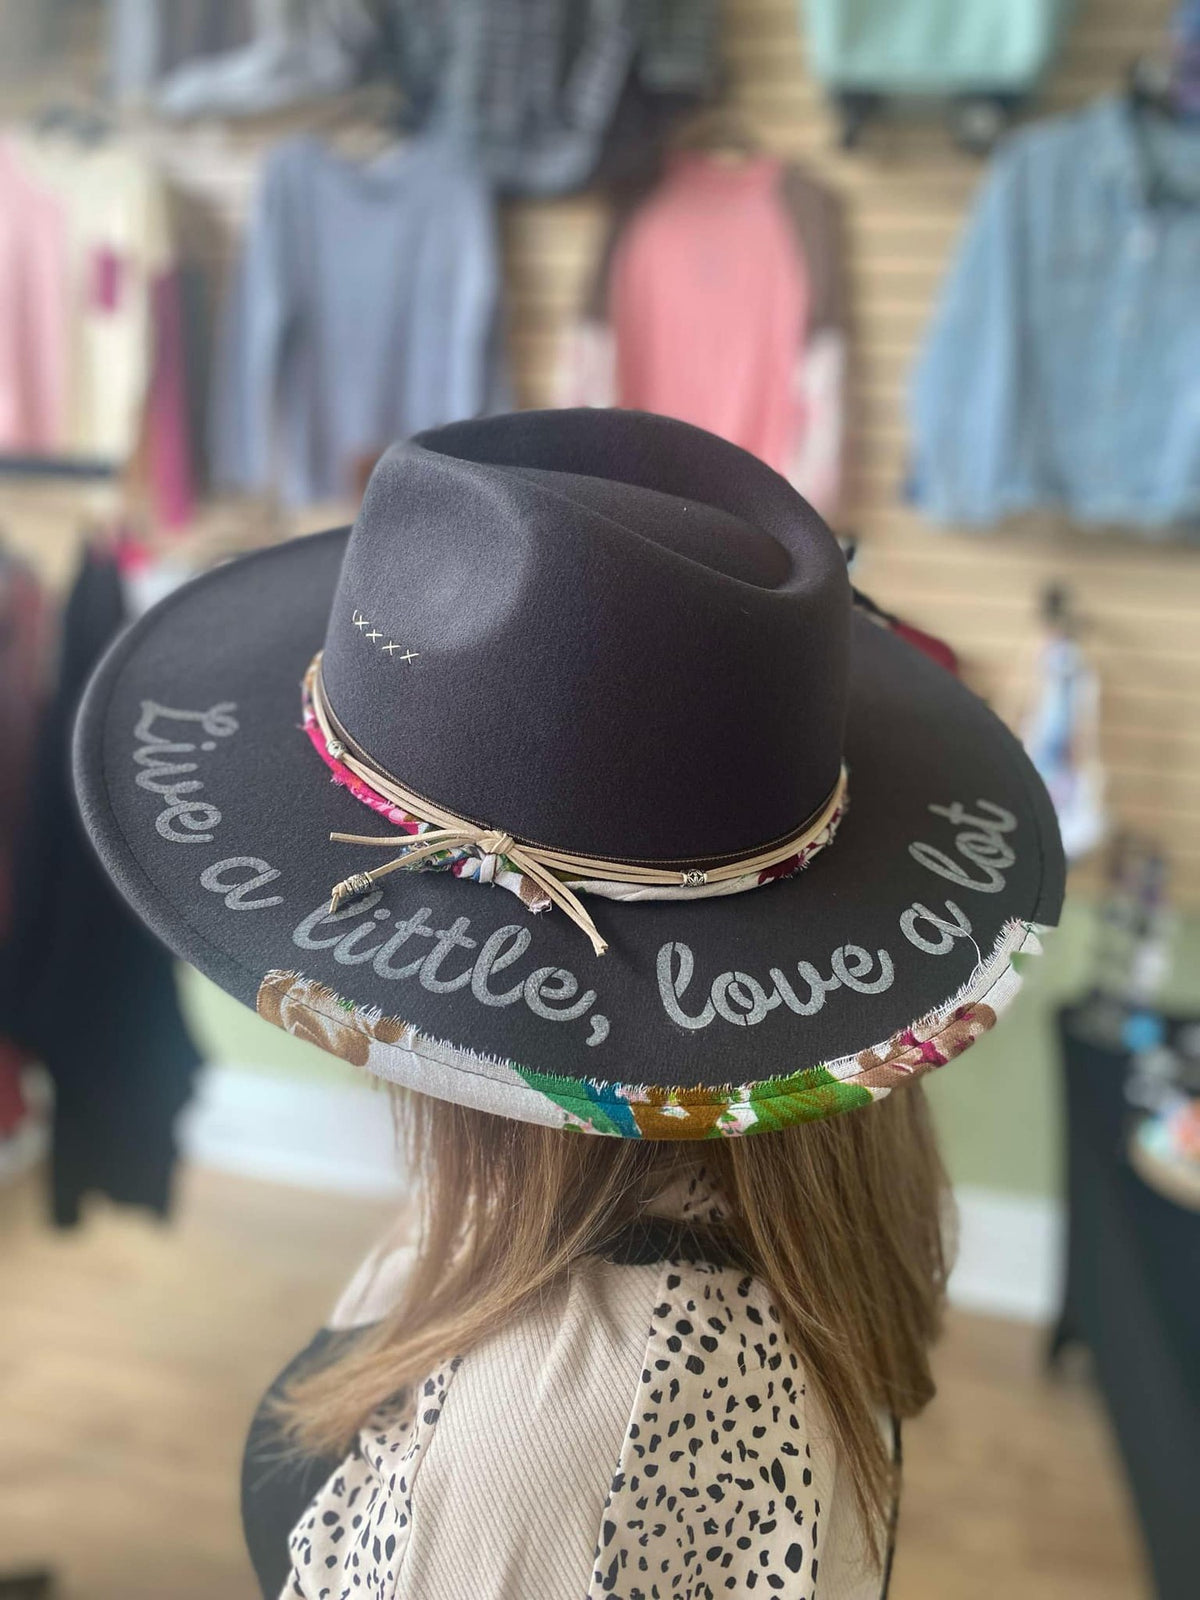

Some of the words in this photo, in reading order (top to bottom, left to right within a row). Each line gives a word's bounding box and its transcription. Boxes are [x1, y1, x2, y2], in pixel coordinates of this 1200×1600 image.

[133, 700, 239, 844] Live
[200, 856, 284, 911] a
[908, 799, 1018, 894] lot
[292, 889, 610, 1047] little,
[900, 899, 974, 955] a
[656, 941, 895, 1030] love
